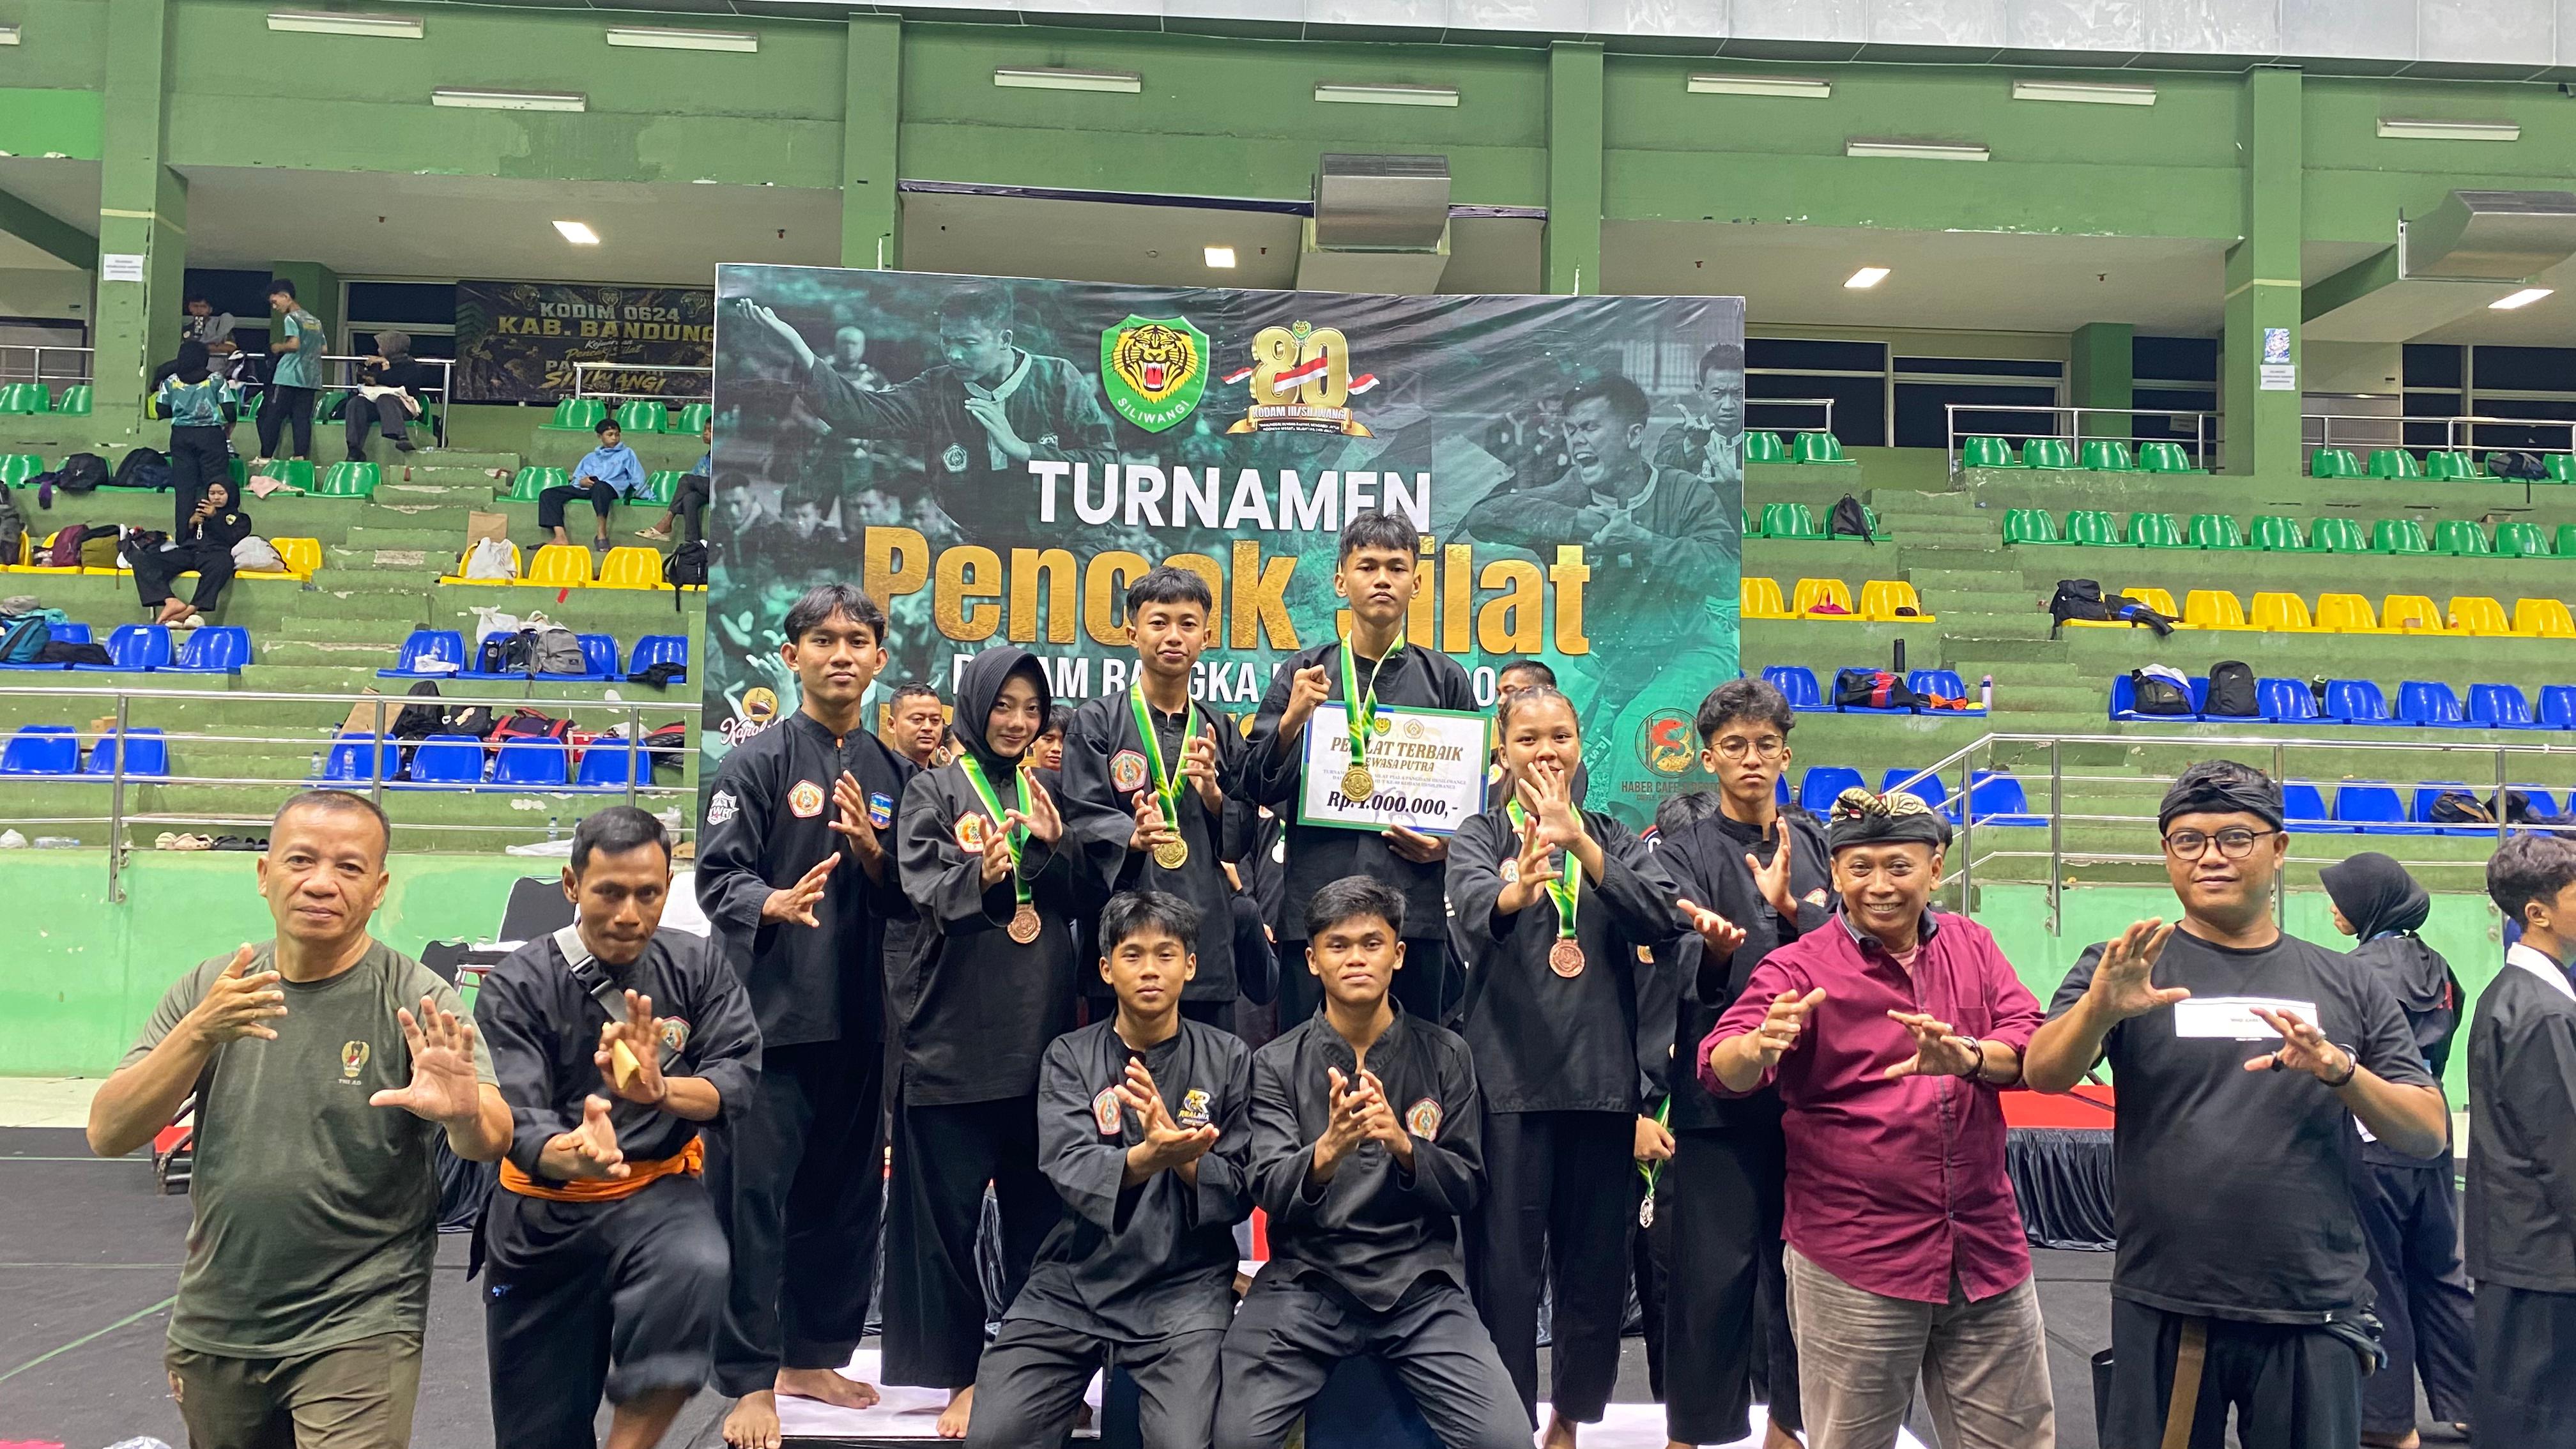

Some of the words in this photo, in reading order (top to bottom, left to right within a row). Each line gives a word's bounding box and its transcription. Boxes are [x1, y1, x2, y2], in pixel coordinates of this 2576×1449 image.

[540, 302, 615, 319] KODIM
[624, 307, 680, 322] 0624
[498, 317, 571, 337] KAB.
[1117, 397, 1190, 424] SILIWANGI
[1252, 406, 1285, 418] KODAM
[1028, 460, 1430, 533] TURNAMEN
[1337, 535, 1591, 656] ilat
[1102, 659, 1259, 703] RGKA
[1330, 737, 1394, 756] PELAT
[1395, 742, 1463, 762] TERBAIK
[1365, 757, 1399, 769] EWASA
[1401, 760, 1434, 772] PUTRA
[1621, 781, 1653, 793] HABER
[1655, 781, 1678, 793] CAFE
